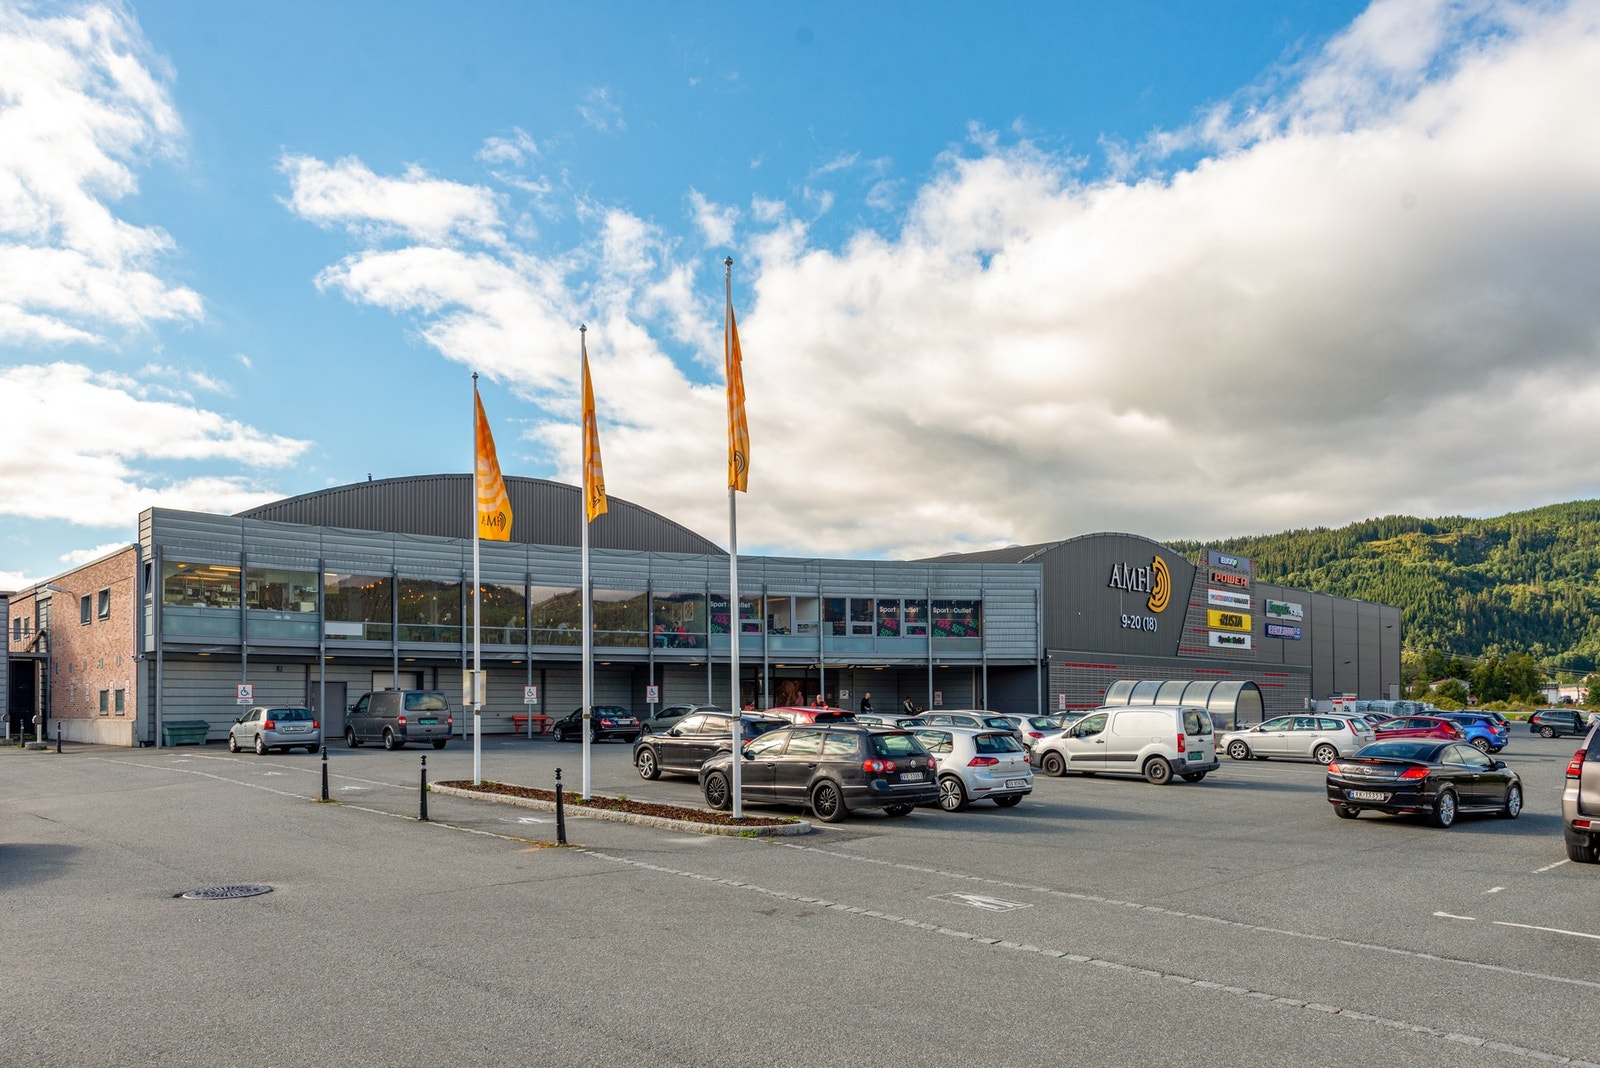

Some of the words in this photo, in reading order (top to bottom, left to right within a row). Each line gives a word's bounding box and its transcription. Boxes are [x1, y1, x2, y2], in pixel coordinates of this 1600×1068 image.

[1110, 562, 1151, 592] AMFI
[1214, 572, 1247, 586] POWER
[1121, 614, 1141, 629] 9-20
[1143, 616, 1158, 632] (18)
[1221, 613, 1243, 627] RUSTA
